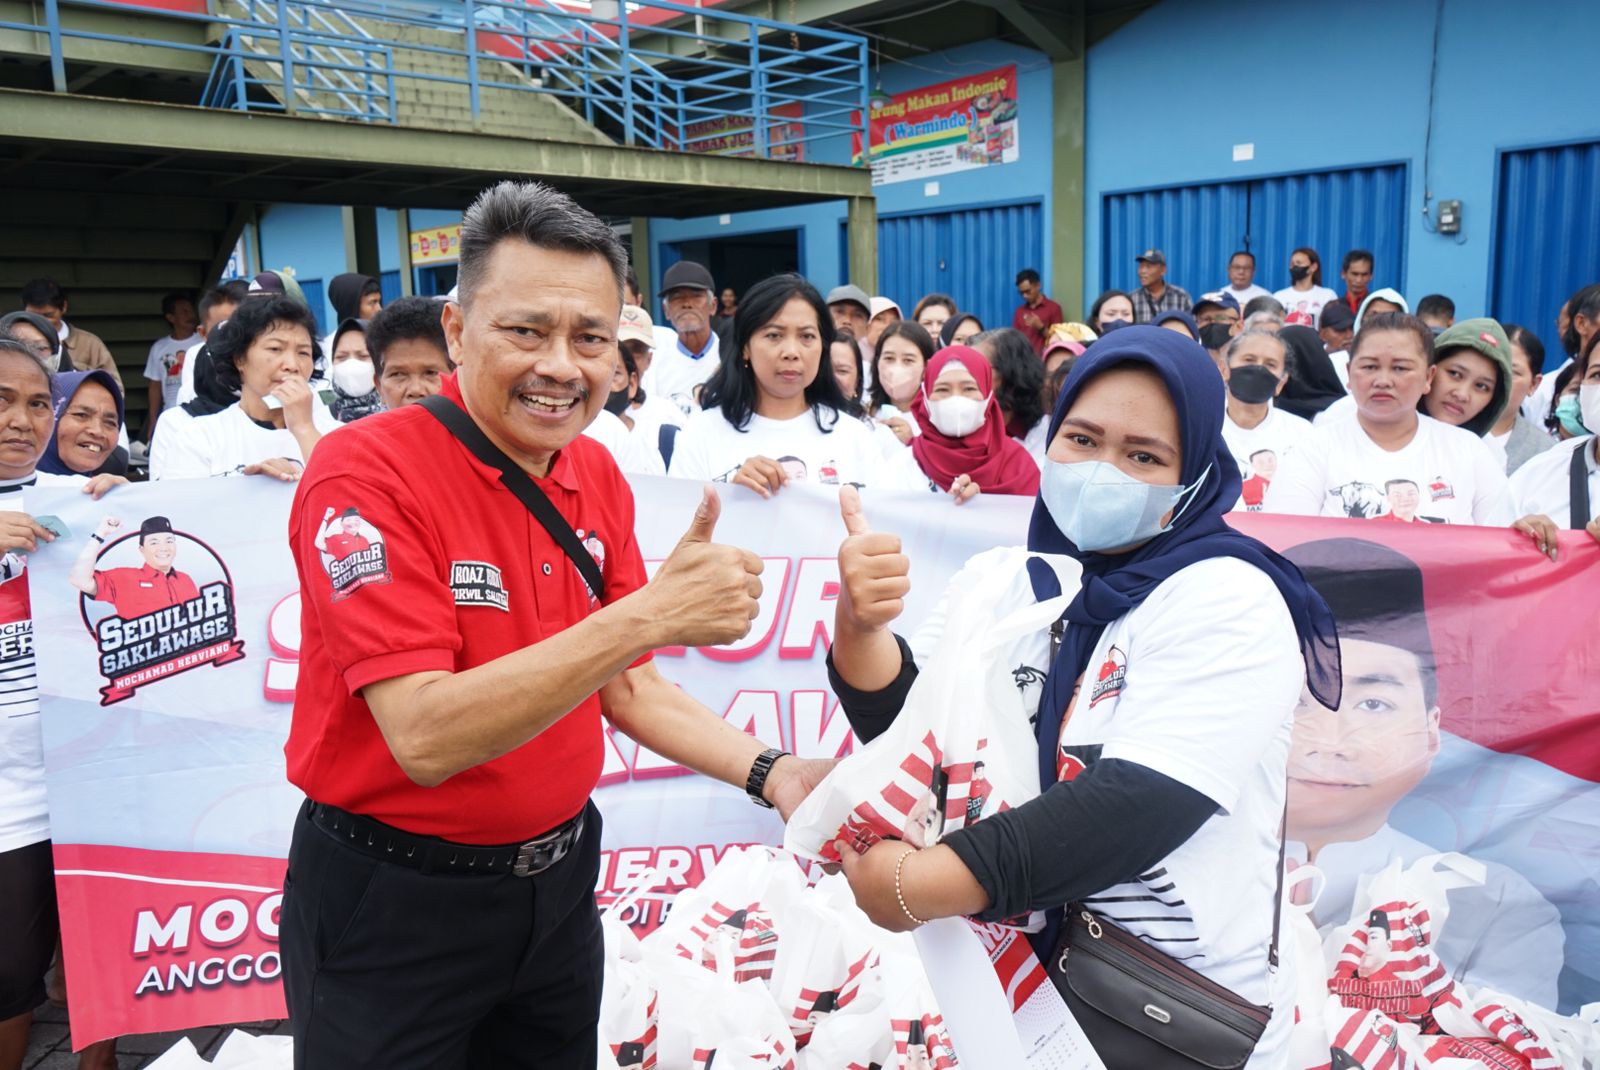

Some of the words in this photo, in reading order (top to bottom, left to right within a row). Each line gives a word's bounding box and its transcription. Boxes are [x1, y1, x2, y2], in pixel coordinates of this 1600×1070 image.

[869, 102, 905, 119] arung
[908, 91, 949, 113] Makan
[951, 77, 1007, 102] Indomie
[331, 544, 382, 578] SEDULUR
[333, 560, 383, 588] SAKLAWASE
[455, 566, 485, 584] BOAZ
[451, 588, 484, 601] ORWIL
[0, 621, 32, 635] CHA
[100, 583, 227, 651] SEDULUR
[0, 634, 32, 658] ER
[103, 616, 228, 674] SAKLAWASE
[116, 662, 174, 689] MOCHAMAD
[178, 644, 230, 668] HERVIANO
[135, 952, 282, 995] ANGGO
